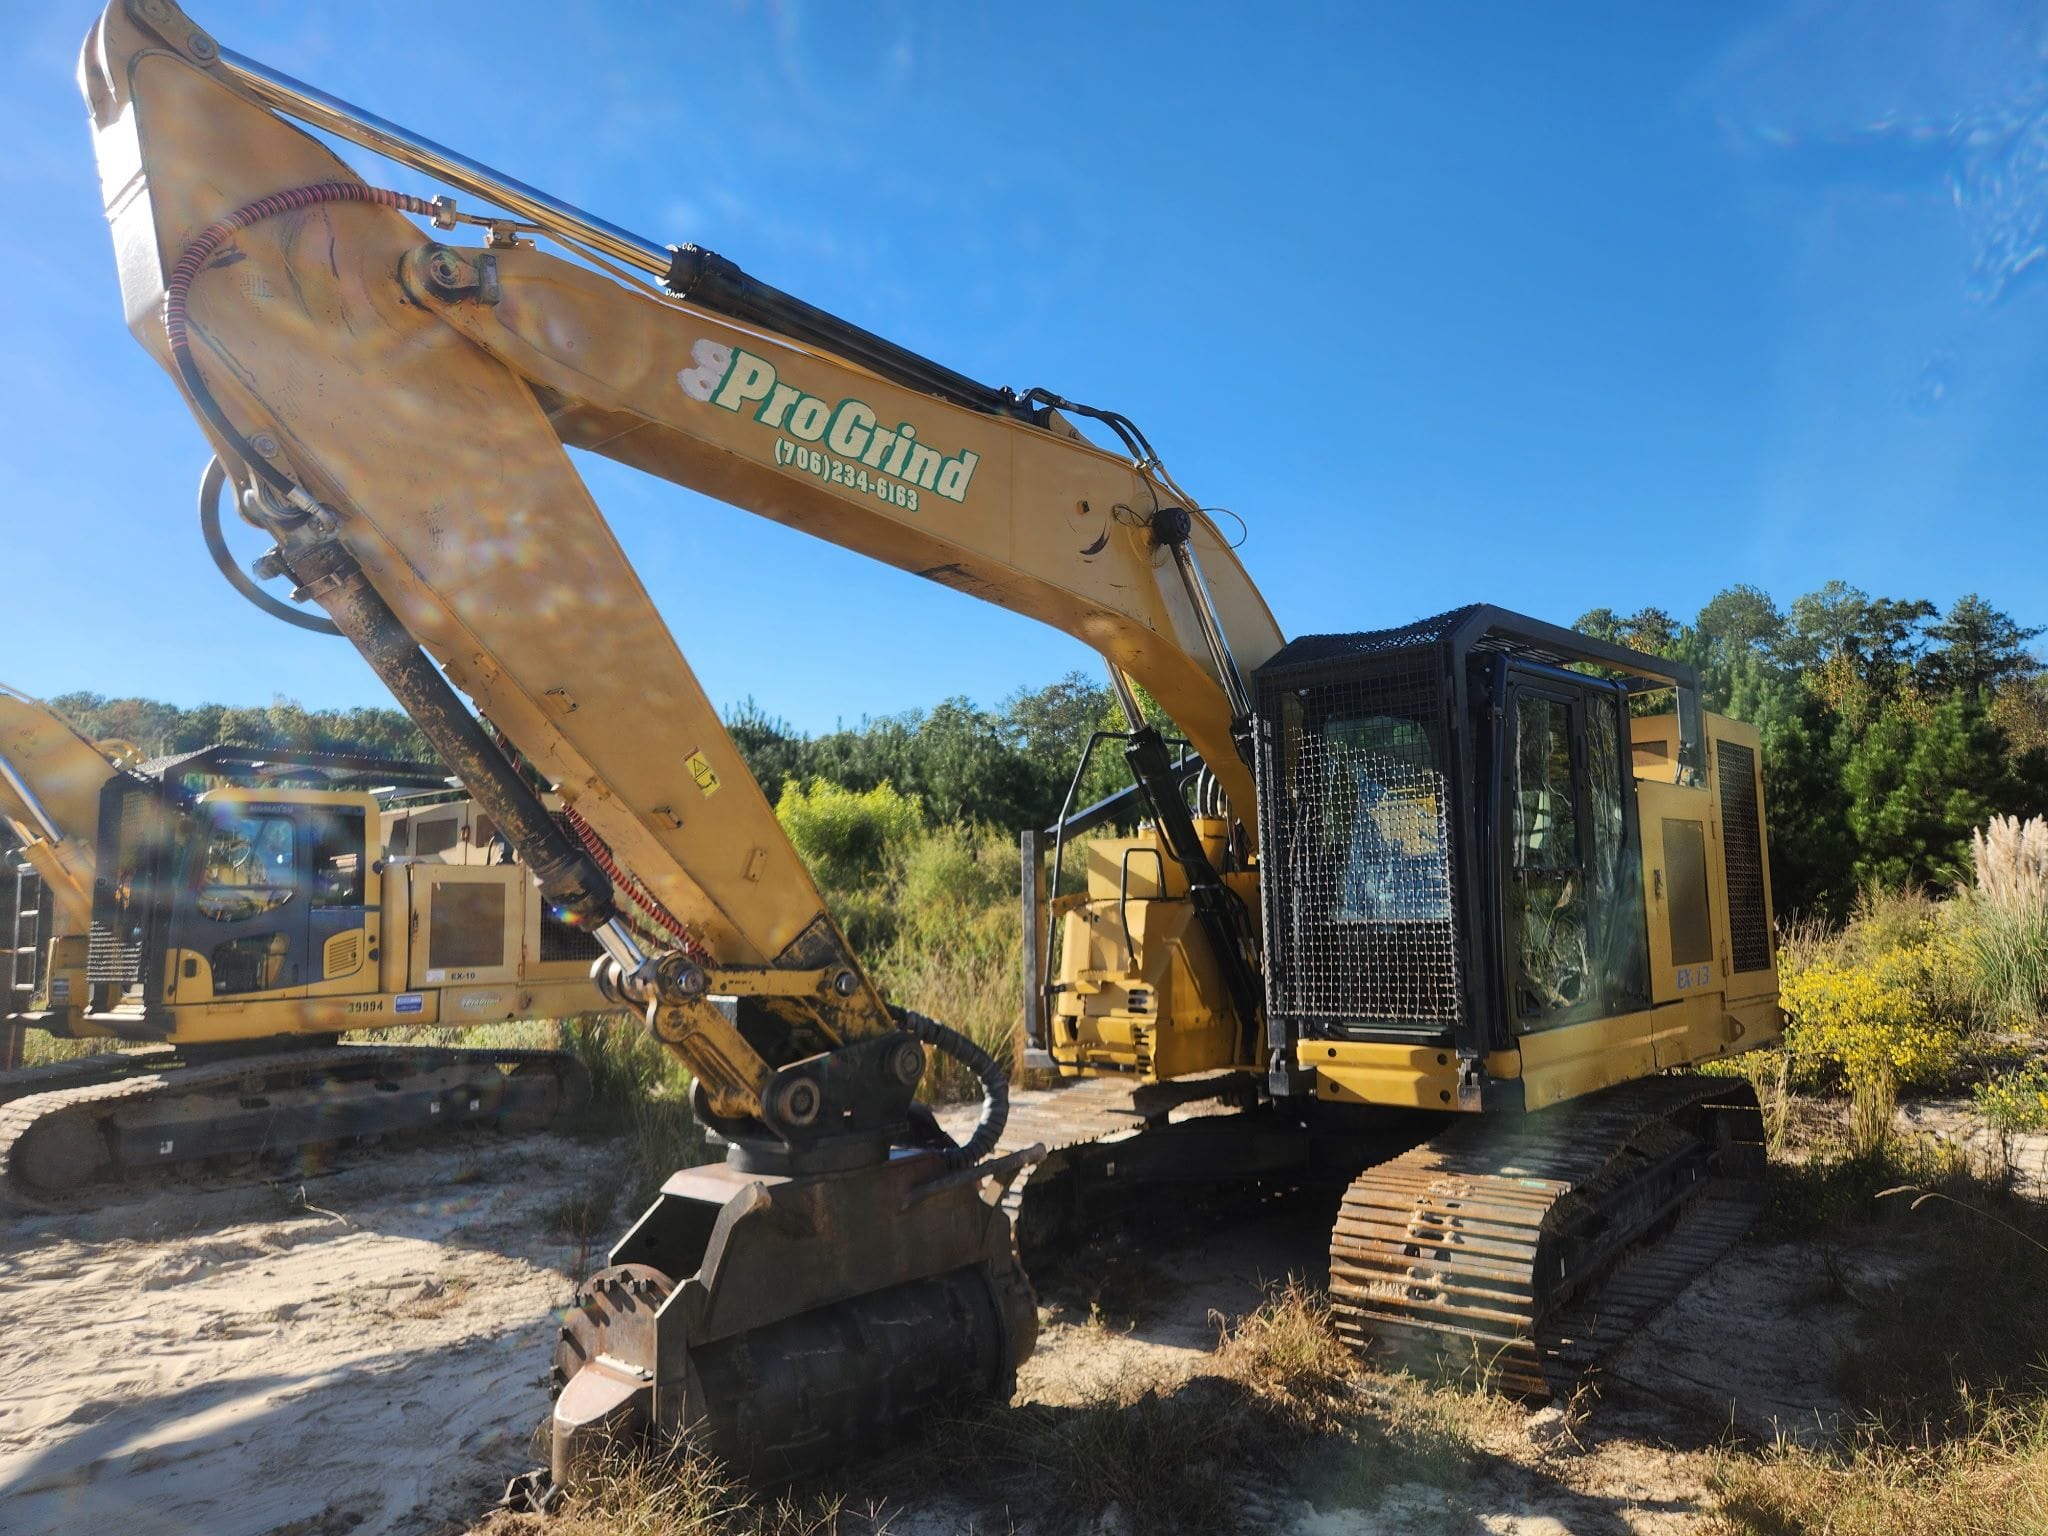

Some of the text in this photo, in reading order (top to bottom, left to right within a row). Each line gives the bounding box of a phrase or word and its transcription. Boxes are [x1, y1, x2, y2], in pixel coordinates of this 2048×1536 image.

[709, 347, 980, 503] ProGrind
[775, 437, 919, 512] (706)234-6163
[451, 972, 476, 980] EX-10
